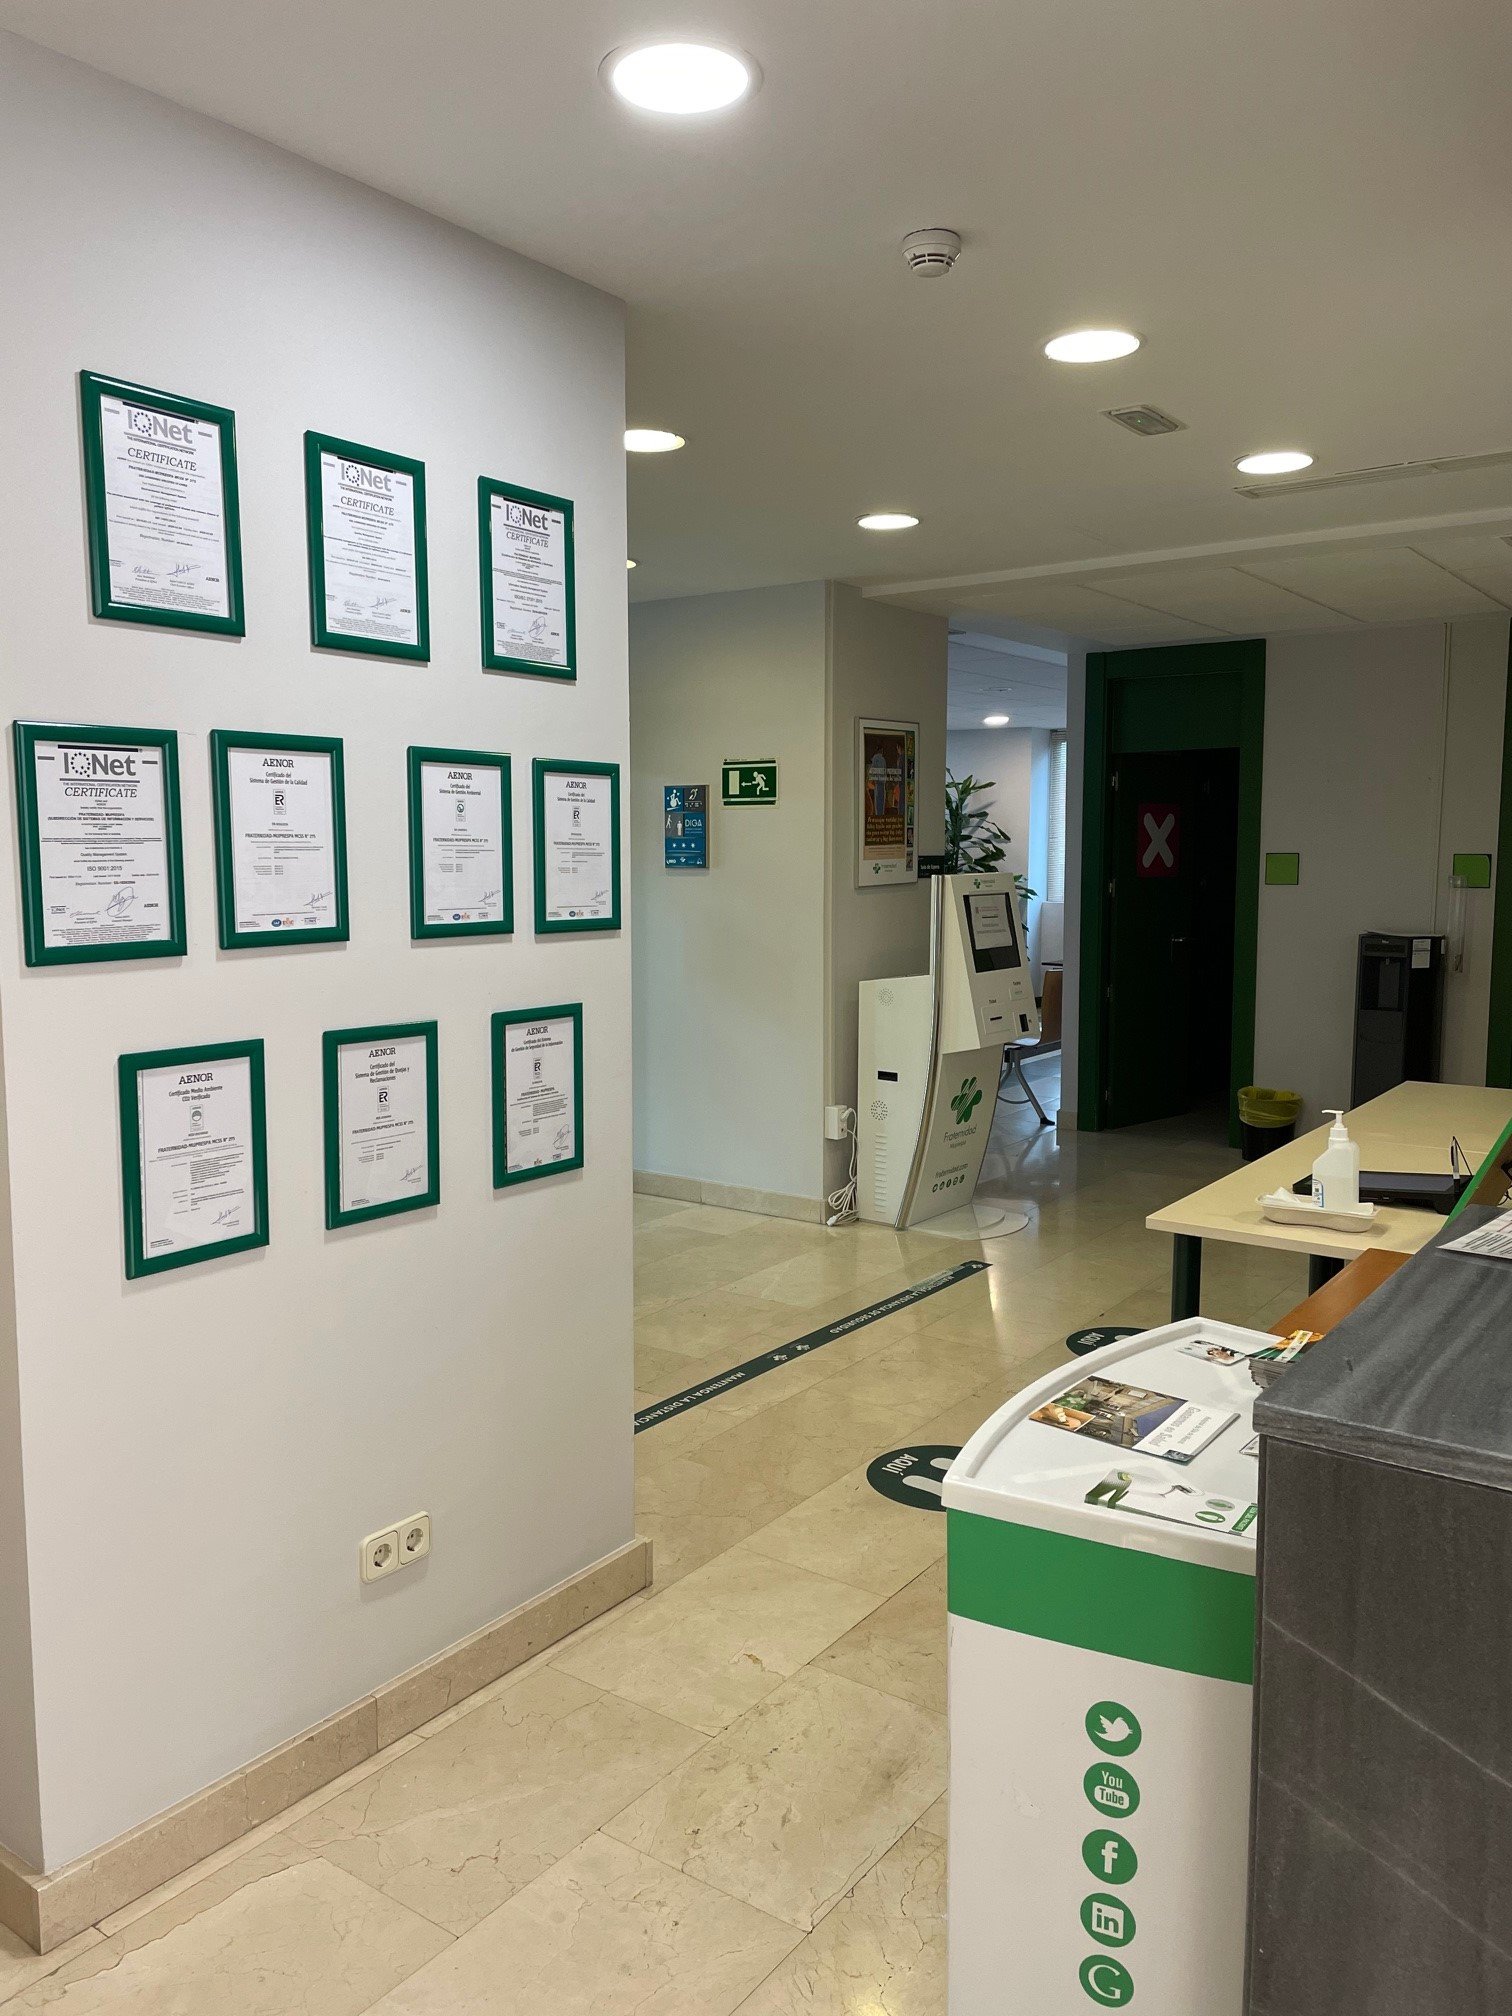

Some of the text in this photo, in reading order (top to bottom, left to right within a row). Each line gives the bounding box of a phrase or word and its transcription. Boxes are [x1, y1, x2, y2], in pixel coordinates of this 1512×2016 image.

[127, 409, 193, 444] IQNet
[128, 448, 196, 471] CERTIFICATE
[341, 463, 391, 492] IQNet
[340, 496, 394, 516] CERTIFICATE
[506, 504, 548, 530] IQNet
[506, 531, 548, 548] CERTIFICATE
[64, 752, 136, 778] IQNet
[262, 758, 294, 768] AENOR
[447, 772, 473, 780] AENOR
[566, 781, 587, 789] AENOR
[64, 786, 137, 798] CERTIFICATE
[685, 819, 702, 827] DIGA
[526, 1026, 548, 1036] AENOR
[369, 1047, 396, 1058] AENOR
[179, 1073, 213, 1085] AENOR
[943, 1124, 977, 1142] Fraternidad
[1077, 1332, 1105, 1346] AQUÍ
[692, 1371, 746, 1397] MANTENGA
[680, 1395, 696, 1403] LA
[882, 1454, 919, 1476] AQUÍ
[1102, 1770, 1122, 1788] You
[1099, 1787, 1124, 1805] Tube
[1101, 1840, 1118, 1874] f
[1096, 1908, 1119, 1934] in
[1088, 1964, 1121, 1999] G
